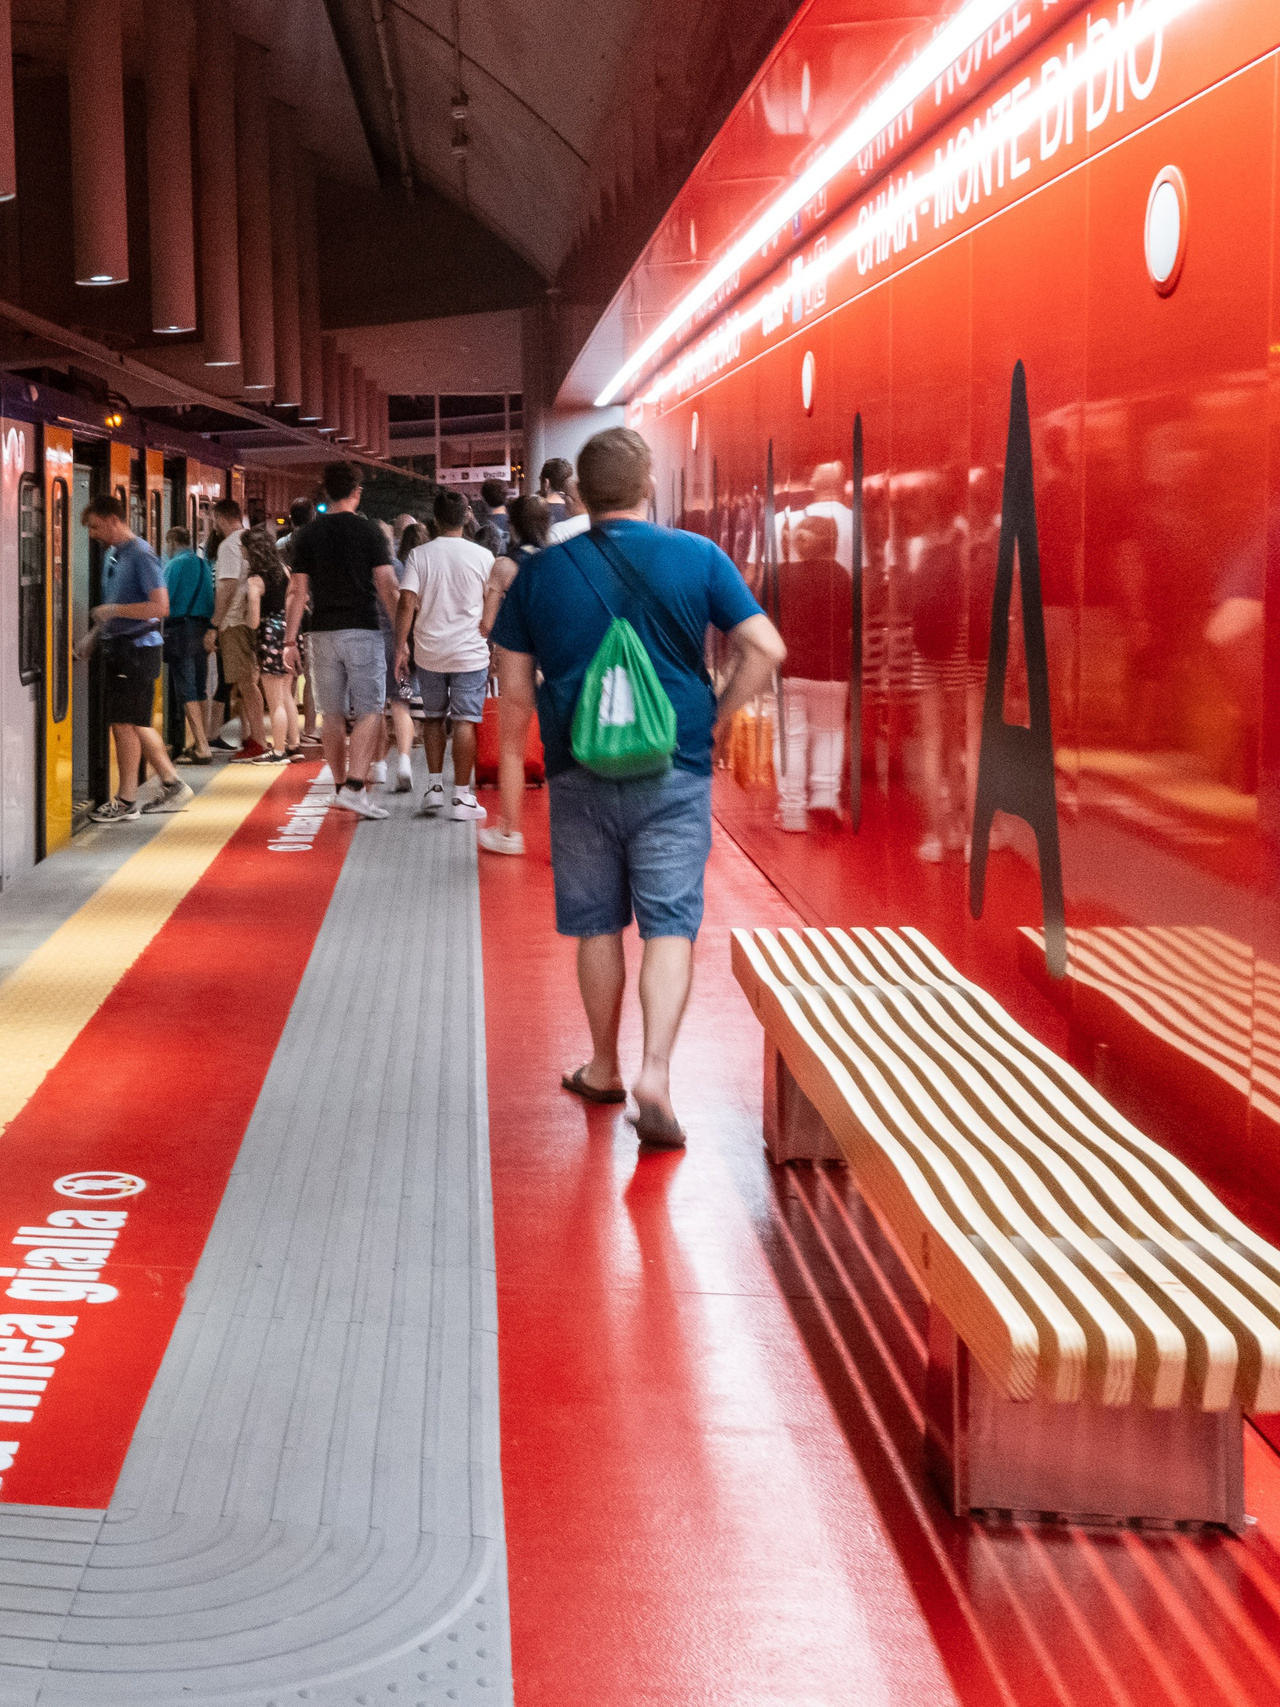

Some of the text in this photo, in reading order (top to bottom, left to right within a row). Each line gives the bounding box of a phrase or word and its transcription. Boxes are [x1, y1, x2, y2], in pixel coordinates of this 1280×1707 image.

[933, 76, 1031, 229] MONTE
[1040, 42, 1075, 161] DI
[1086, 0, 1164, 133] DIO
